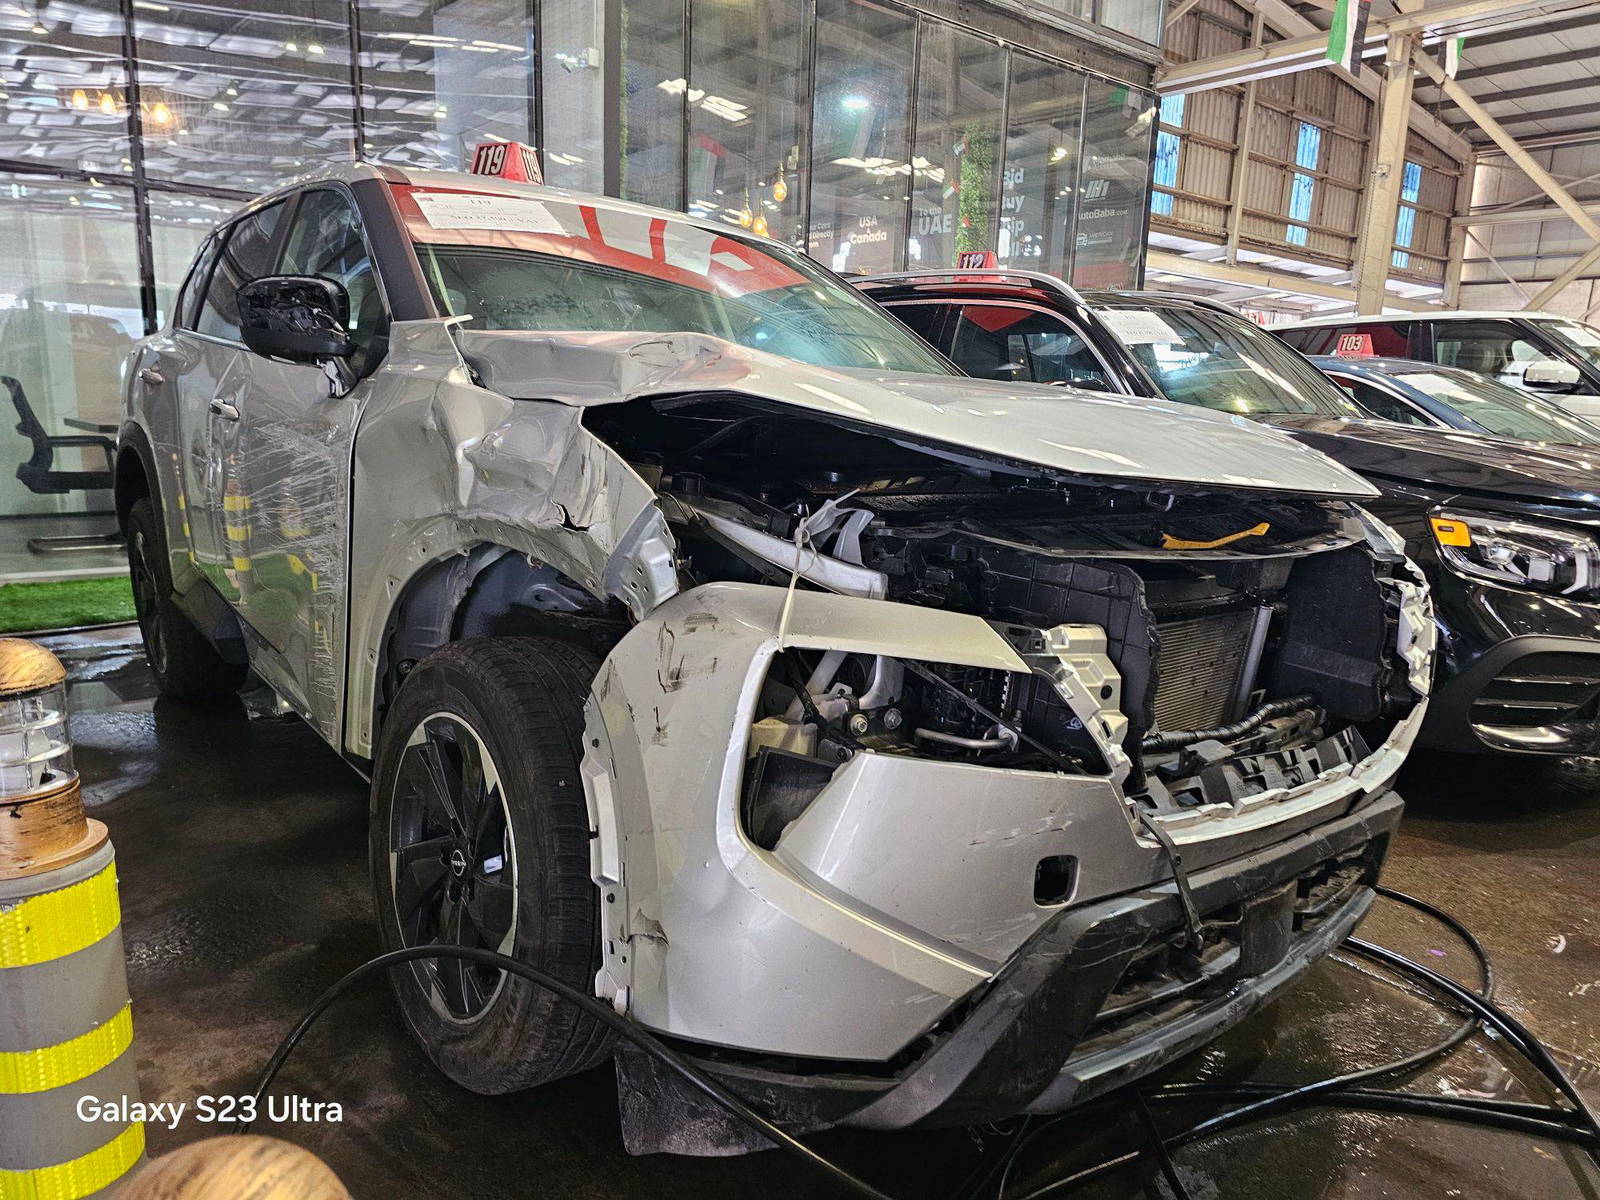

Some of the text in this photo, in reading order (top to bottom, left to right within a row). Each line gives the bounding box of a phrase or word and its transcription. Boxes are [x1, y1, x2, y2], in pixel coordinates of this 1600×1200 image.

[478, 145, 505, 174] 119
[1002, 195, 1025, 212] uy
[859, 215, 878, 228] USA
[919, 214, 953, 236] UAE
[850, 230, 887, 244] Canada
[1341, 336, 1363, 351] 103
